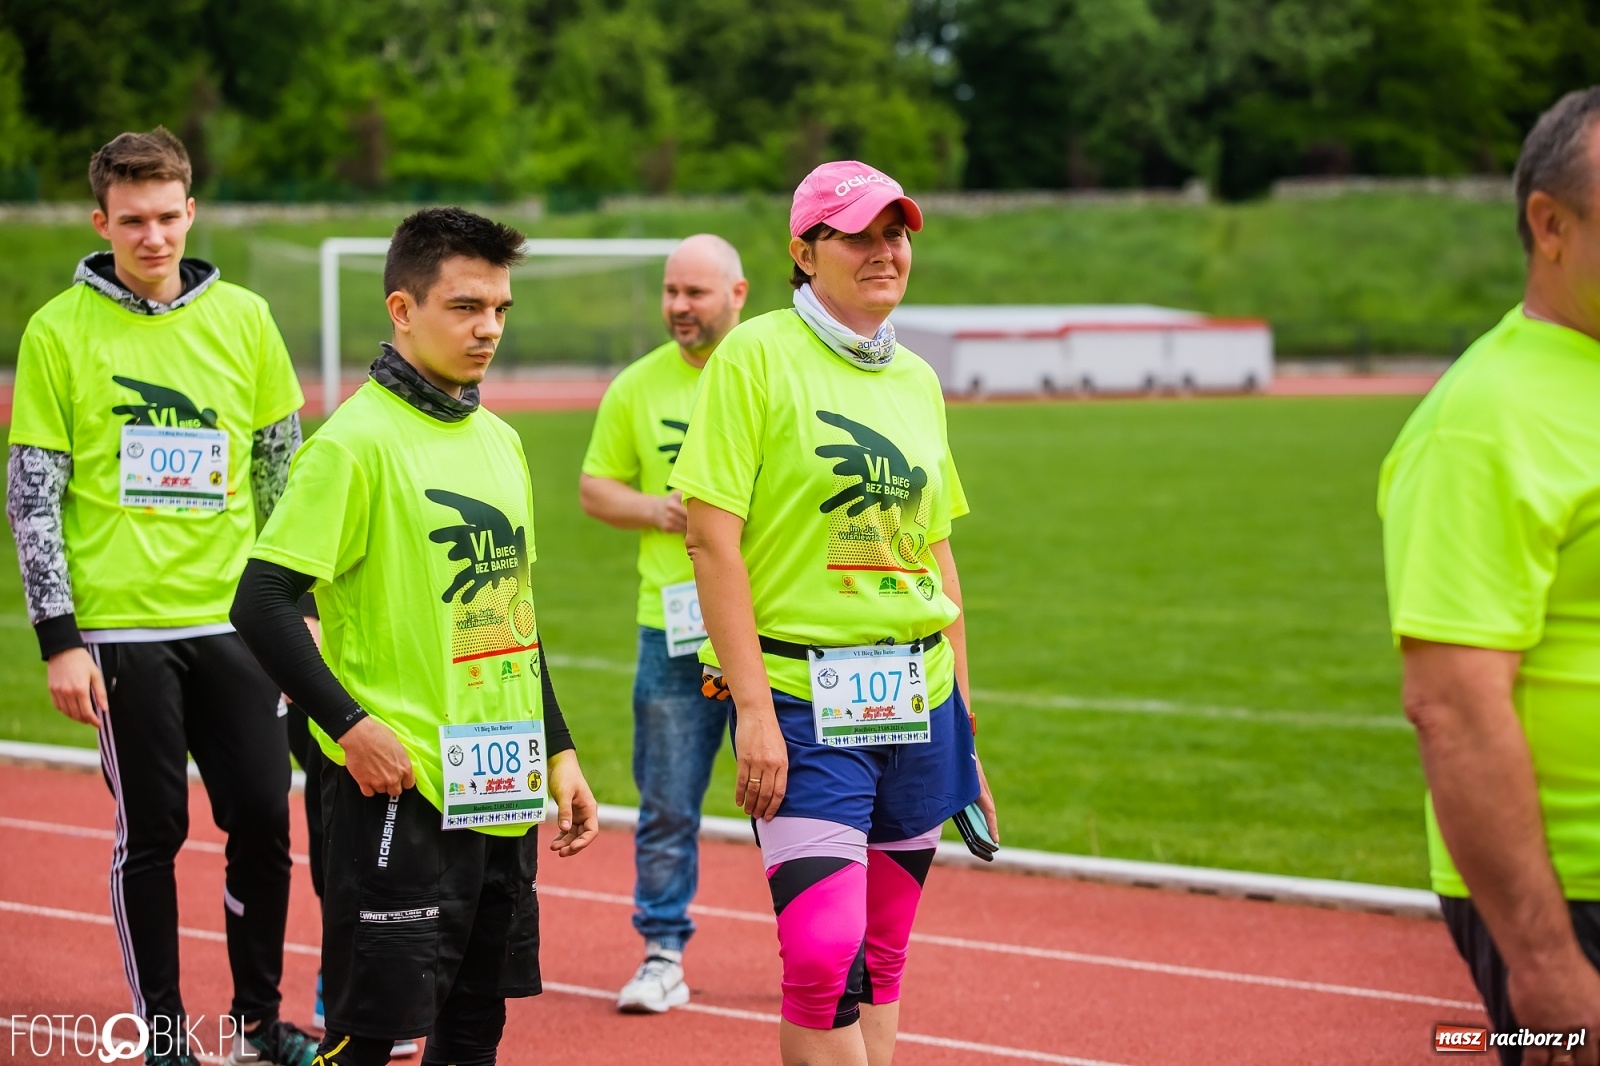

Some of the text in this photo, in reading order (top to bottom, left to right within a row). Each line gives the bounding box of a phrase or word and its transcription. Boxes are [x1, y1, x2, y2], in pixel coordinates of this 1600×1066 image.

[148, 407, 178, 428] VI
[212, 445, 221, 458] R
[150, 448, 203, 474] 007
[864, 453, 891, 484] VI
[892, 475, 910, 488] BIEG
[866, 482, 910, 501] BEZ BARIER
[469, 530, 495, 562] VI
[495, 545, 515, 558] BIEG
[475, 558, 518, 575] BEZ BARIER
[909, 662, 919, 678] R
[849, 671, 902, 704] 107
[528, 739, 540, 757] R
[471, 740, 521, 776] 108
[386, 803, 398, 820] WE
[380, 821, 395, 856] CRUSH
[378, 857, 389, 868] IN
